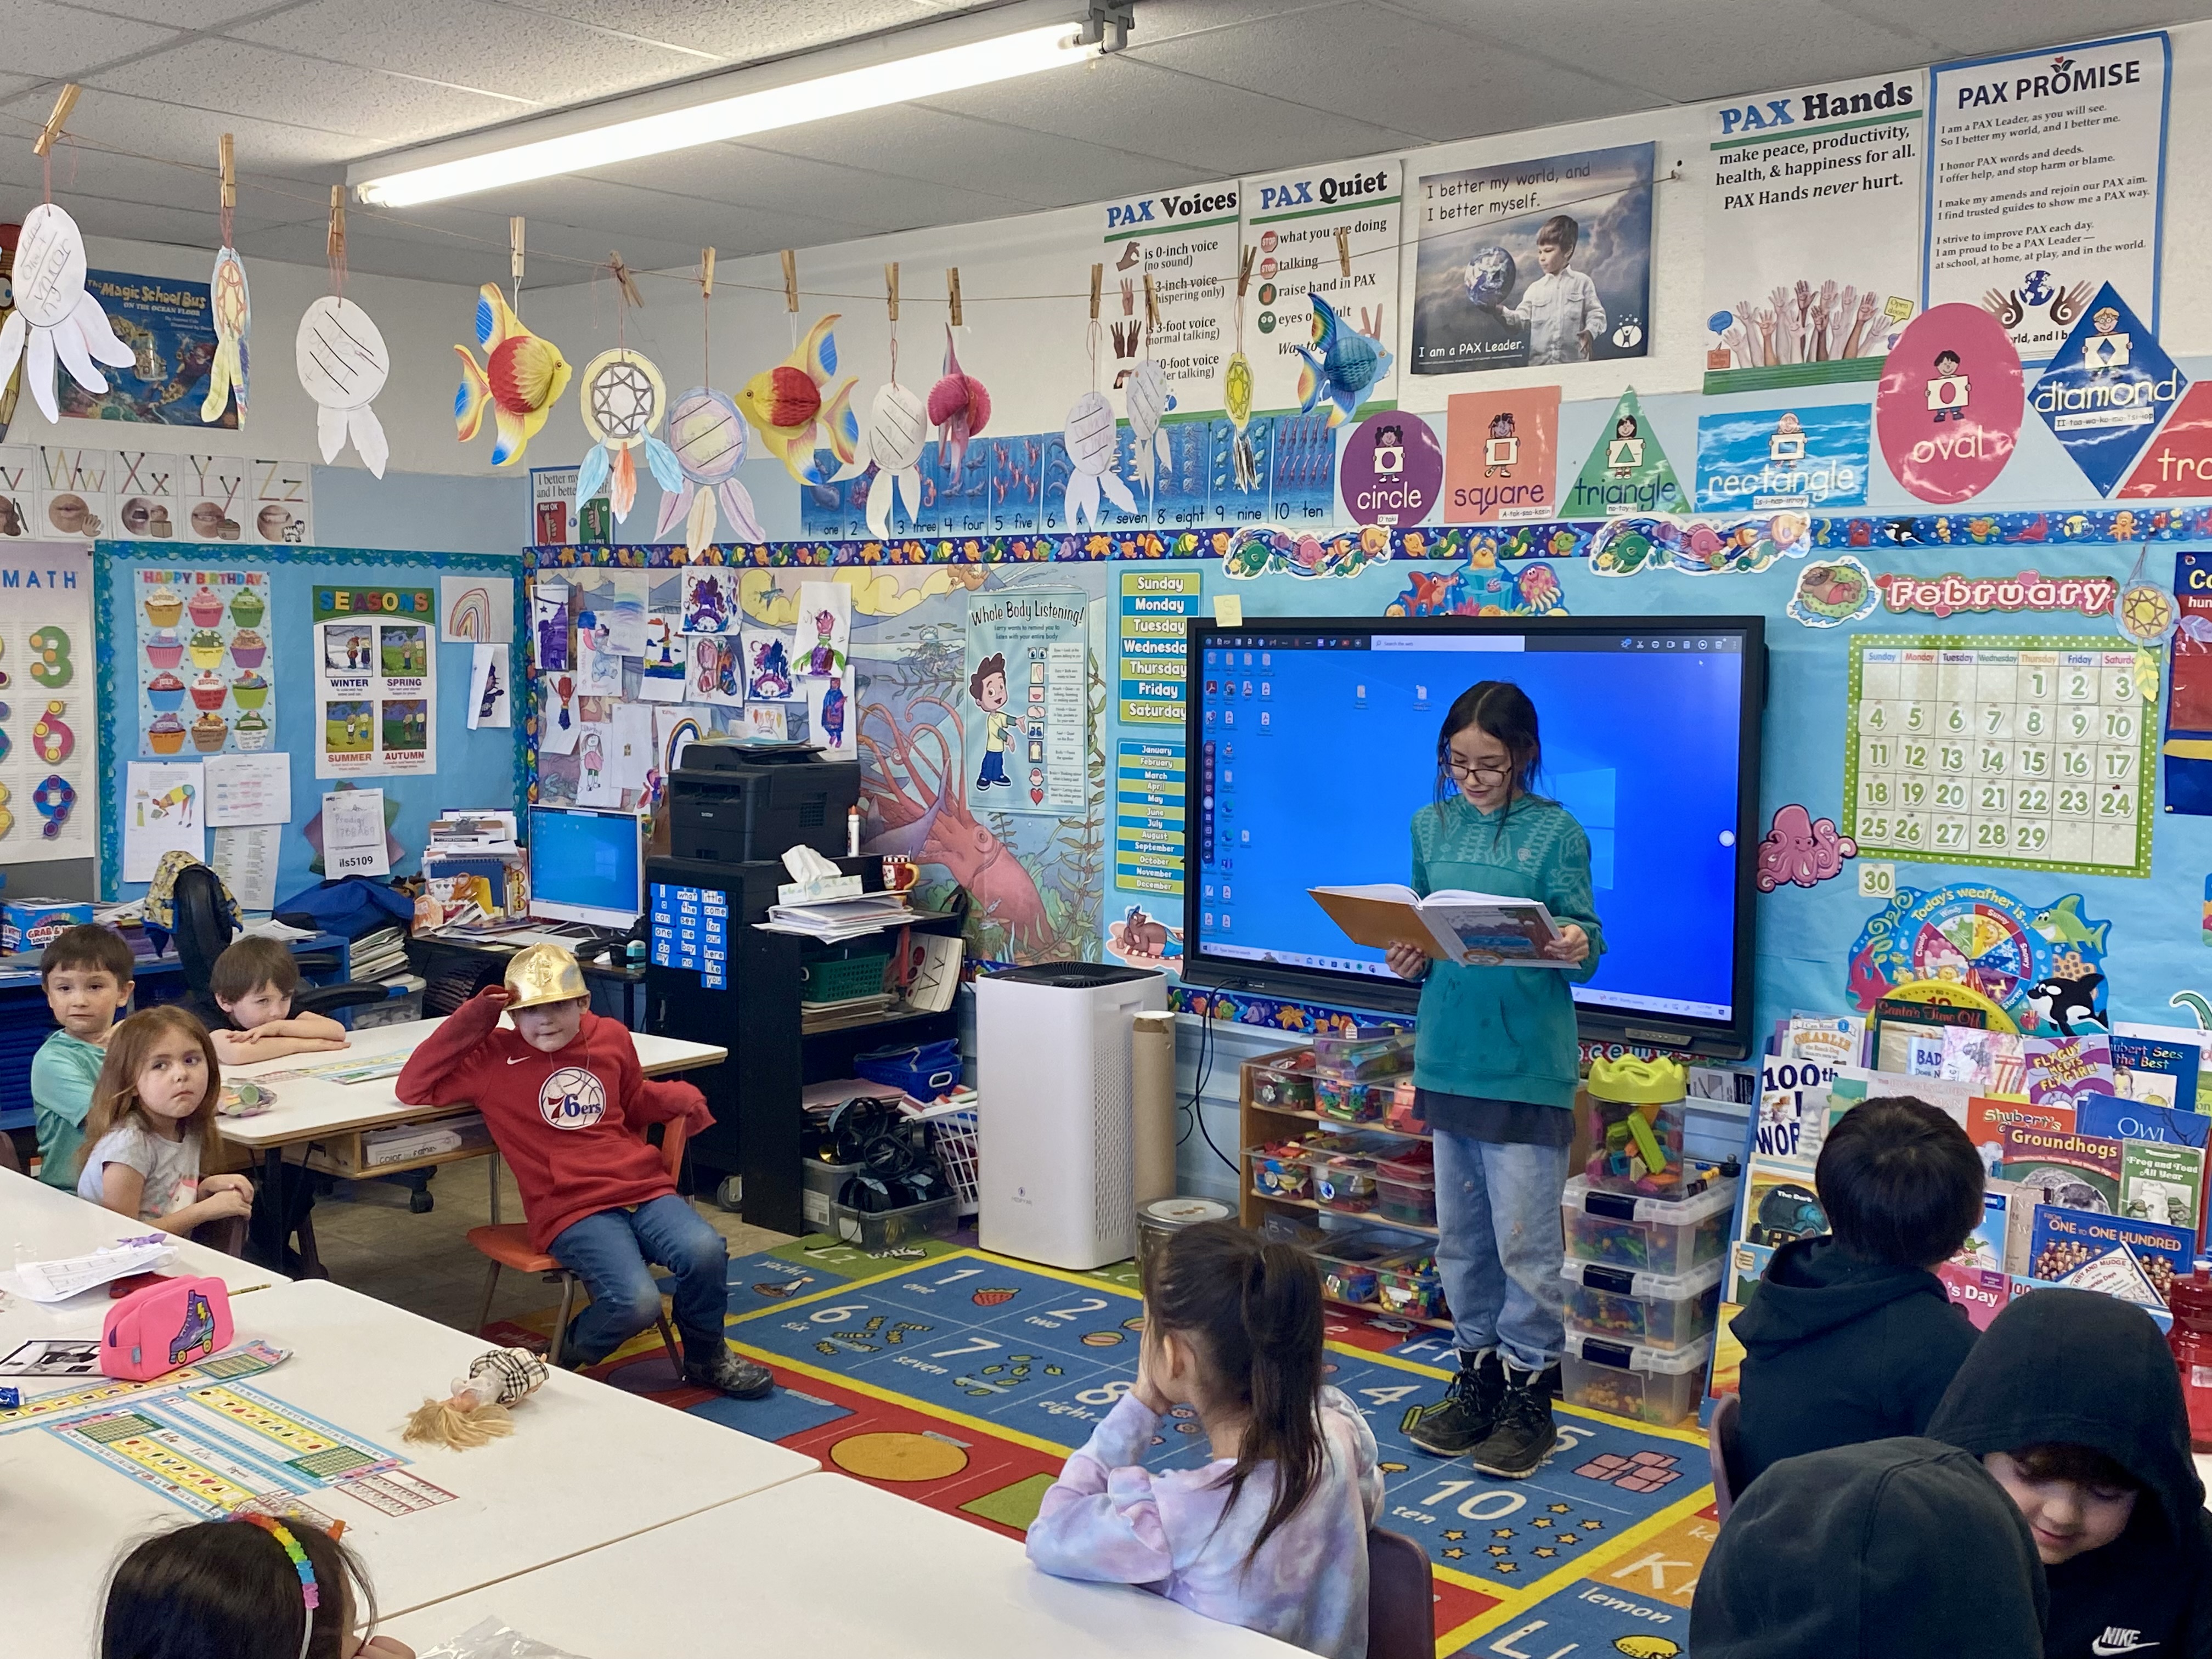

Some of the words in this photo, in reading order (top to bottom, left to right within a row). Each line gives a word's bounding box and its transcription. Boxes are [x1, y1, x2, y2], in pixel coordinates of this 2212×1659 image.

[1959, 81, 2008, 109] PAX
[2017, 60, 2140, 100] PROMISE
[1719, 99, 1795, 134] PAX
[1802, 82, 1913, 121] Hands
[1719, 149, 1758, 165] make
[1763, 143, 1809, 162] peace,
[1813, 126, 1909, 154] productivity,
[1717, 168, 1765, 185] health,
[1770, 165, 1781, 178] &
[1785, 154, 1862, 176] happiness
[1866, 150, 1888, 163] for
[1893, 144, 1915, 160] all.
[1940, 163, 1944, 171] I
[1947, 160, 1975, 170] honor
[1977, 156, 1997, 166] PAX
[2000, 152, 2029, 163] words
[2032, 149, 2050, 159] and
[2053, 145, 2084, 157] deeds.
[1427, 185, 1433, 199] I
[1441, 178, 1485, 197] better
[1491, 178, 1509, 192] my
[1516, 167, 1559, 185] world,
[1566, 162, 1590, 179] and
[1261, 182, 1313, 209] PAX
[1320, 171, 1387, 204] Quiet
[1107, 200, 1155, 228] PAX
[1161, 193, 1237, 218] Voices
[1428, 208, 1433, 221] I
[1441, 201, 1484, 219] better
[1489, 193, 1540, 215] myself.
[1280, 230, 1307, 243] what
[1310, 228, 1329, 242] you
[1355, 219, 1387, 233] doing
[1145, 249, 1153, 259] is
[1156, 243, 1188, 258] 0-inch
[1192, 240, 1218, 252] voice
[1144, 260, 1159, 273] (no
[1161, 255, 1193, 268] sound)
[1280, 257, 1318, 270] talking
[1279, 284, 1306, 296] raise
[1310, 278, 1336, 292] hand
[1340, 278, 1350, 289] in
[1355, 274, 1376, 287] PAX
[100, 283, 140, 301] Magic
[142, 285, 181, 305] School
[181, 292, 206, 309] Bus
[1419, 346, 1425, 358] I
[1429, 346, 1445, 357] am
[1449, 346, 1455, 356] a
[1459, 343, 1482, 355] PAX
[1485, 340, 1525, 353] Leader.
[2035, 369, 2177, 413] diamond
[1913, 425, 1984, 463] oval
[1709, 460, 1854, 501] rectangle
[1357, 484, 1422, 510] circle
[1454, 484, 1544, 515] square
[1575, 479, 1678, 513] triangle
[1116, 514, 1148, 523] seven
[1176, 505, 1204, 529] eight
[1238, 506, 1261, 521] nine
[1303, 501, 1323, 518] ten
[913, 517, 936, 533] three
[963, 515, 984, 531] four
[1014, 513, 1032, 529] five
[3, 569, 77, 589] MATH
[143, 571, 191, 584] HAPPY
[196, 572, 262, 585] BIRTHDAY
[1138, 577, 1183, 592] Sunday
[319, 591, 428, 612] SEASONS
[1891, 580, 2113, 611] February
[972, 603, 1003, 626] Whole
[1006, 600, 1031, 621] Body
[1035, 600, 1084, 627] Listening!
[1136, 598, 1184, 613] Monday
[1133, 619, 1185, 635] Tuesday
[1124, 640, 1187, 654] Wednesda
[1869, 652, 1895, 662] Sunday
[1906, 653, 1934, 662] Monday
[1943, 653, 1973, 663] Tuesday
[1979, 654, 2017, 663] Wednesday
[2022, 654, 2056, 664] Thursday
[2068, 655, 2092, 665] Friday
[1130, 661, 1187, 678] Thursday
[1139, 682, 1178, 698] Friday
[1130, 703, 1186, 720] Saturday
[2107, 715, 2131, 737] 10
[385, 752, 424, 760] AUTUMN
[1142, 746, 1172, 755] January
[1141, 758, 1173, 768] February
[1145, 771, 1167, 780] March
[1147, 783, 1165, 792] April
[1937, 786, 1963, 806] 20
[1148, 795, 1163, 804] May
[1147, 808, 1164, 816] June
[1148, 819, 1163, 828] July
[1142, 831, 1167, 840] August
[1135, 842, 1174, 853] September
[339, 856, 373, 867] ils5109
[1140, 856, 1169, 865] October
[1137, 867, 1172, 878] November
[1137, 879, 1172, 890] December
[1911, 888, 1955, 921] Today's
[1956, 888, 2014, 908] weather
[1988, 909, 2010, 924] Sunny
[28, 928, 52, 938] GRAB
[704, 948, 723, 958] here
[1915, 933, 1928, 957] Cloudy
[2020, 943, 2030, 968] Snowy
[708, 975, 721, 986] you
[1917, 1049, 1942, 1065] BAD
[2034, 1052, 2056, 1069] FLY
[2057, 1042, 2081, 1060] GUY
[2153, 1047, 2183, 1060] Sees
[2049, 1057, 2083, 1075] MEETS
[2141, 1057, 2169, 1069] Best
[2040, 1076, 2061, 1091] FLY
[2064, 1062, 2098, 1081] GIRL!
[548, 1094, 601, 1119] 76ers
[2118, 1117, 2169, 1144] OWL
[2012, 1130, 2117, 1160] Groundhogs
[2127, 1156, 2152, 1169] Frog
[2154, 1161, 2172, 1169] and
[2173, 1161, 2198, 1173] Toad
[2140, 1168, 2156, 1177] All
[2159, 1170, 2183, 1181] Year
[2049, 1220, 2076, 1234] ONE
[2089, 1227, 2117, 1240] ONE
[2120, 1231, 2181, 1251] HUNDRED
[2085, 1264, 2098, 1274] AND
[902, 1283, 936, 1295] one
[1965, 1284, 1999, 1307] Day
[929, 1338, 1002, 1358] 7
[893, 1355, 949, 1375] seven
[1420, 1480, 1527, 1521] 10
[1391, 1505, 1436, 1524] ten
[1577, 1588, 1673, 1624] lemon
[2102, 1627, 2141, 1645] NIKE
